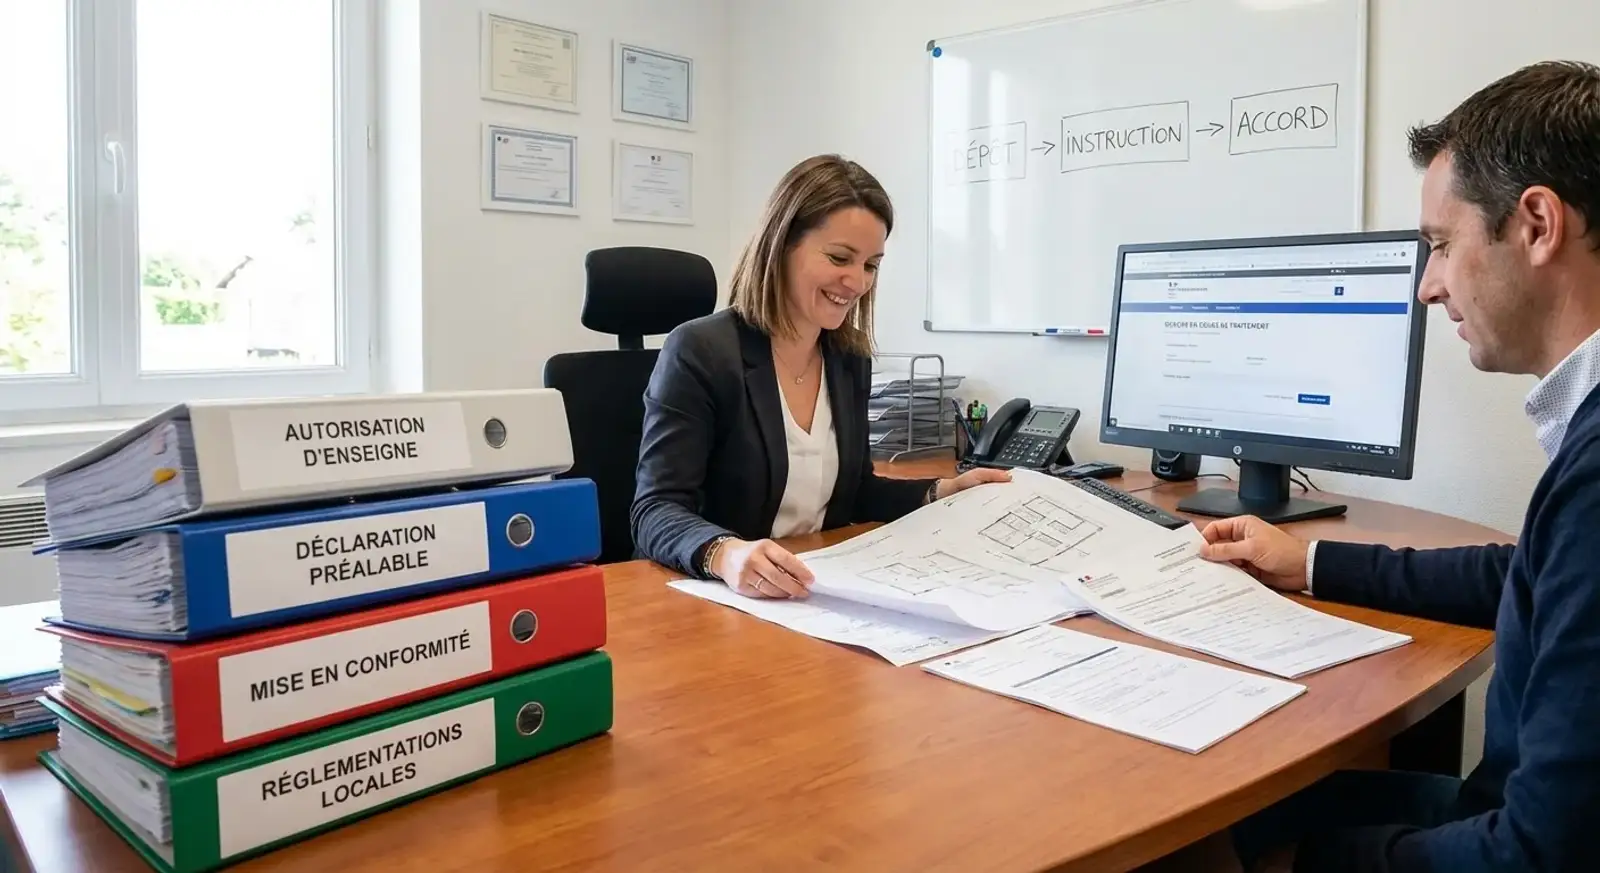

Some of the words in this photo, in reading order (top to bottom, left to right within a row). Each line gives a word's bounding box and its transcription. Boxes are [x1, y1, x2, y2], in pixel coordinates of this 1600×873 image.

[1236, 105, 1329, 137] ACCORD
[285, 417, 425, 442] AUTORISATION
[303, 441, 418, 467] D'ENSEIGNE
[296, 523, 436, 560] DÉCLARATION
[310, 550, 429, 586] PRÉALABLE
[250, 672, 304, 702] MISE
[311, 664, 339, 687] EN
[345, 628, 471, 678] CONFORMITÉ
[261, 723, 463, 801] RÉGLEMENTATIONS
[321, 762, 416, 808] LOCALES
